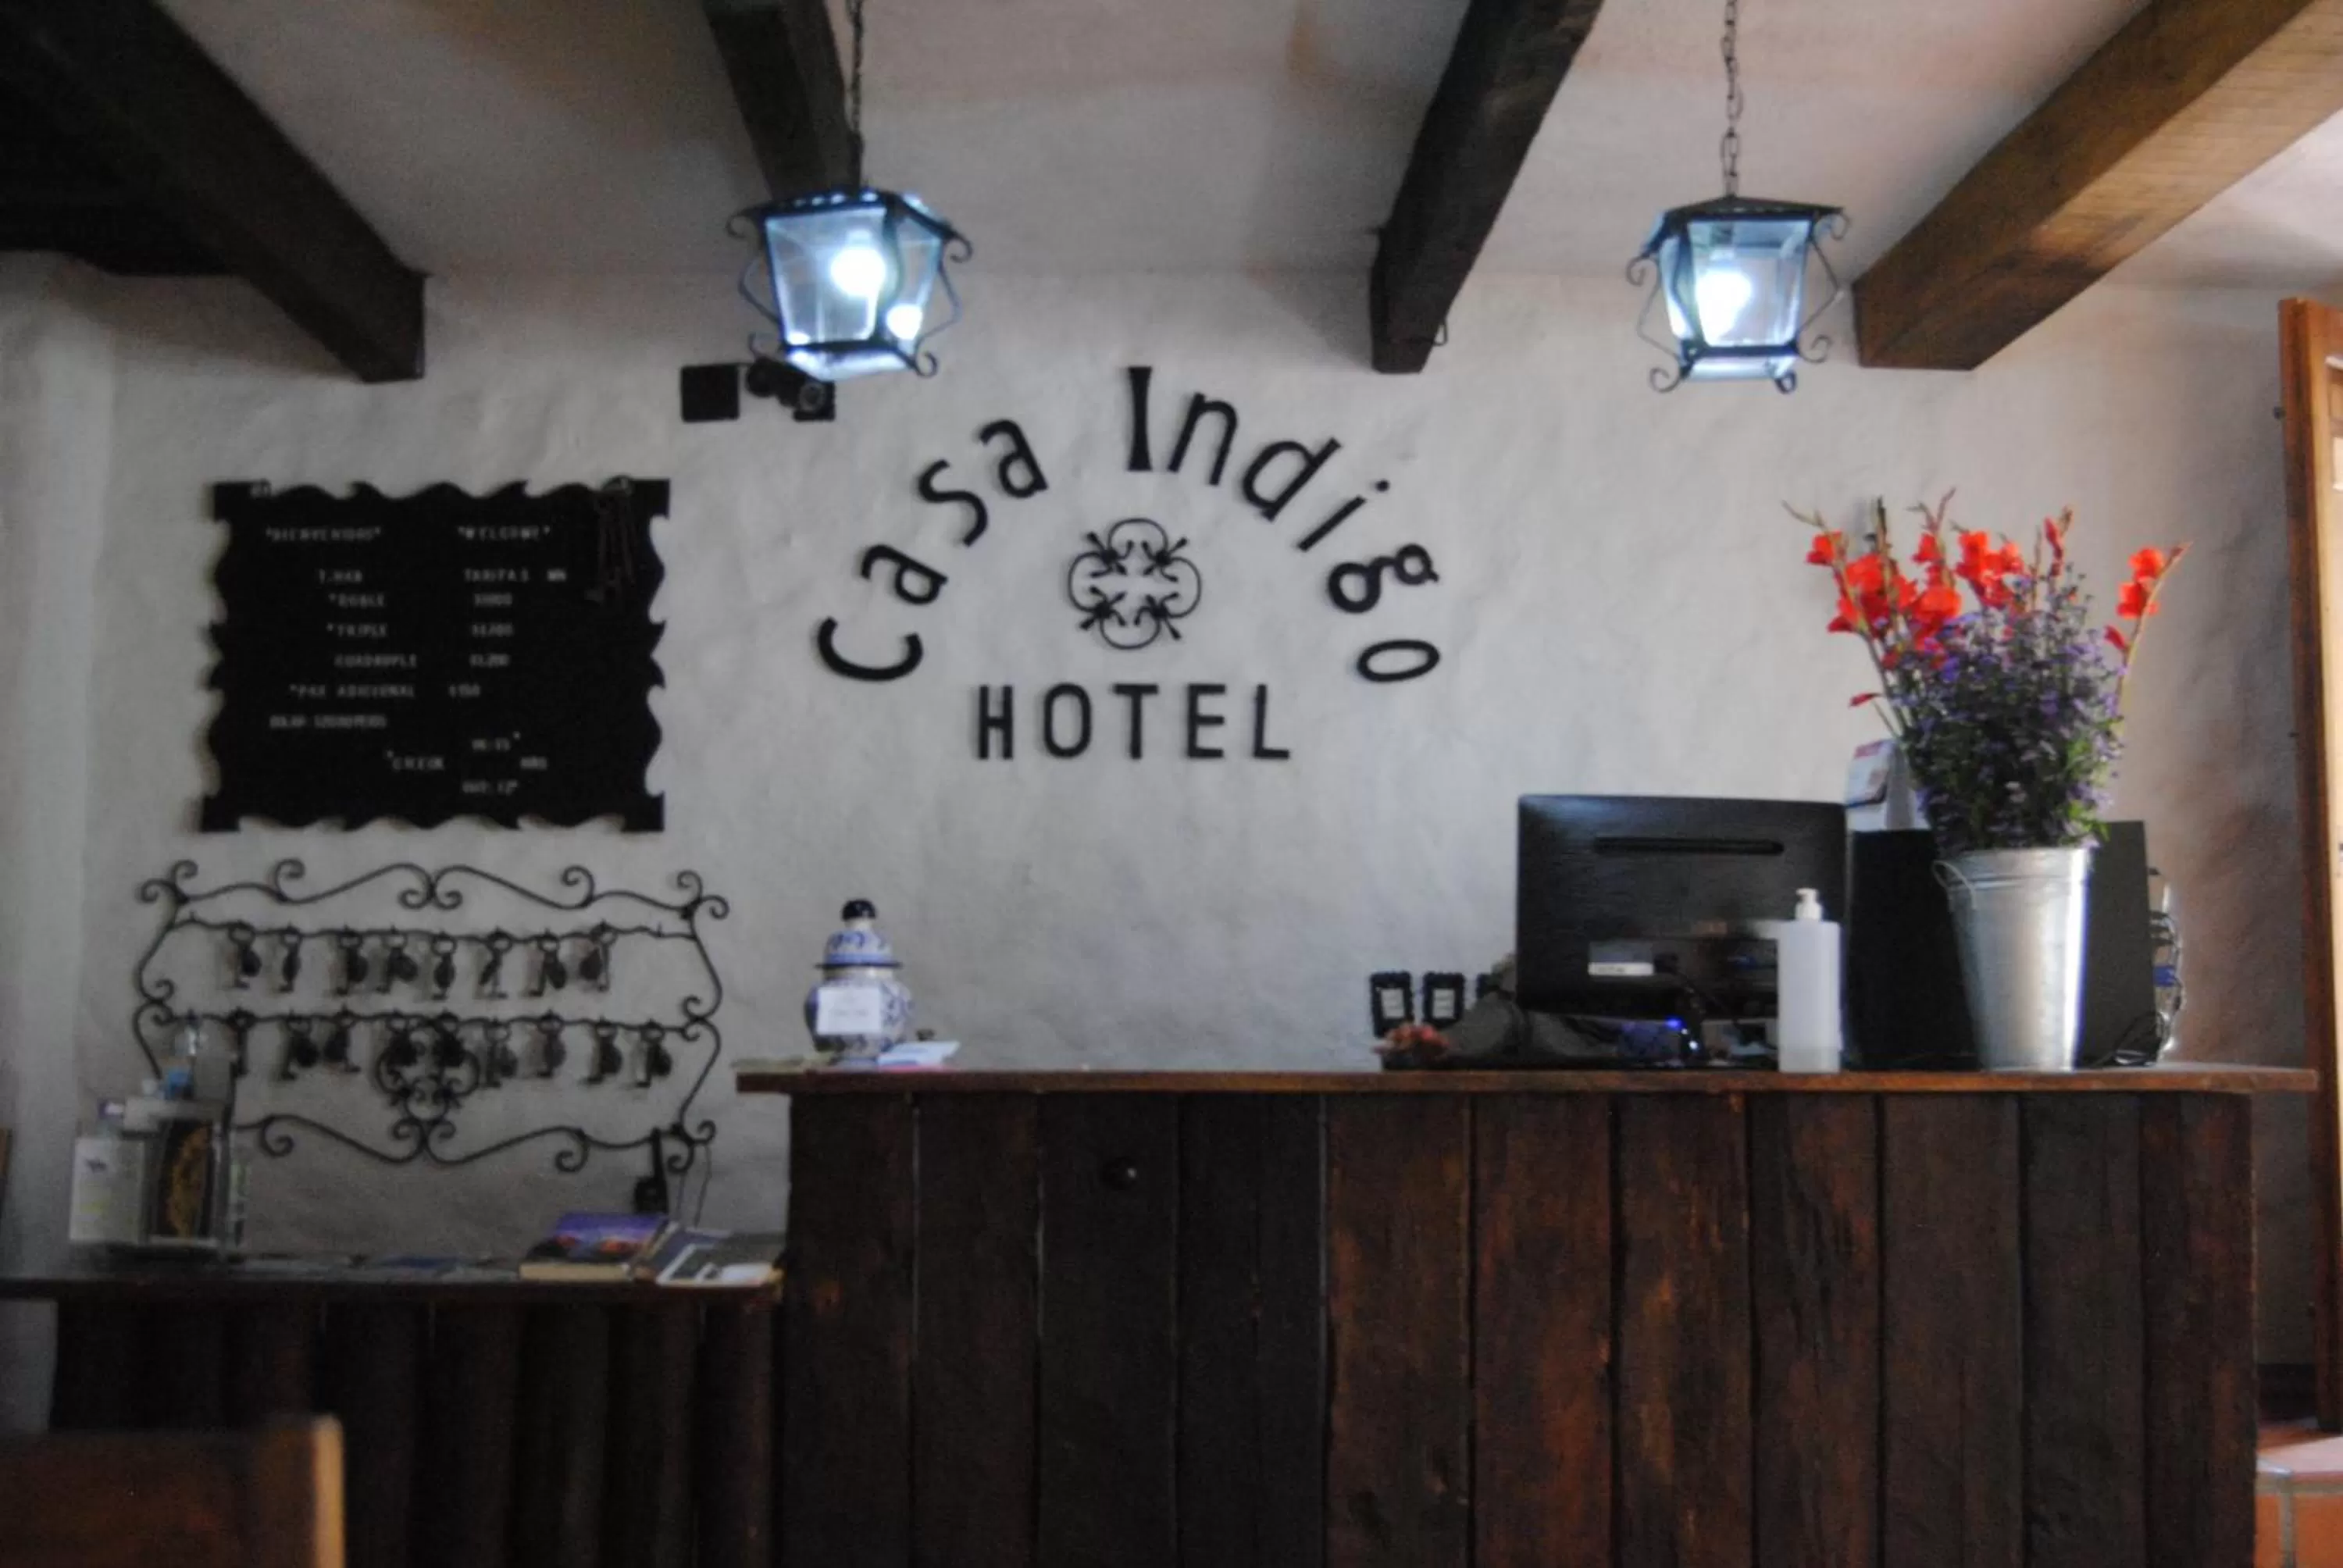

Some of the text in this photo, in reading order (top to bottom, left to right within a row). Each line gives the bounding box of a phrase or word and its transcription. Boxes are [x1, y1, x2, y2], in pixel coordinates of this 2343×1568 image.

[817, 366, 1439, 682] Casa Indigo
[977, 683, 1290, 760] HOTEL
